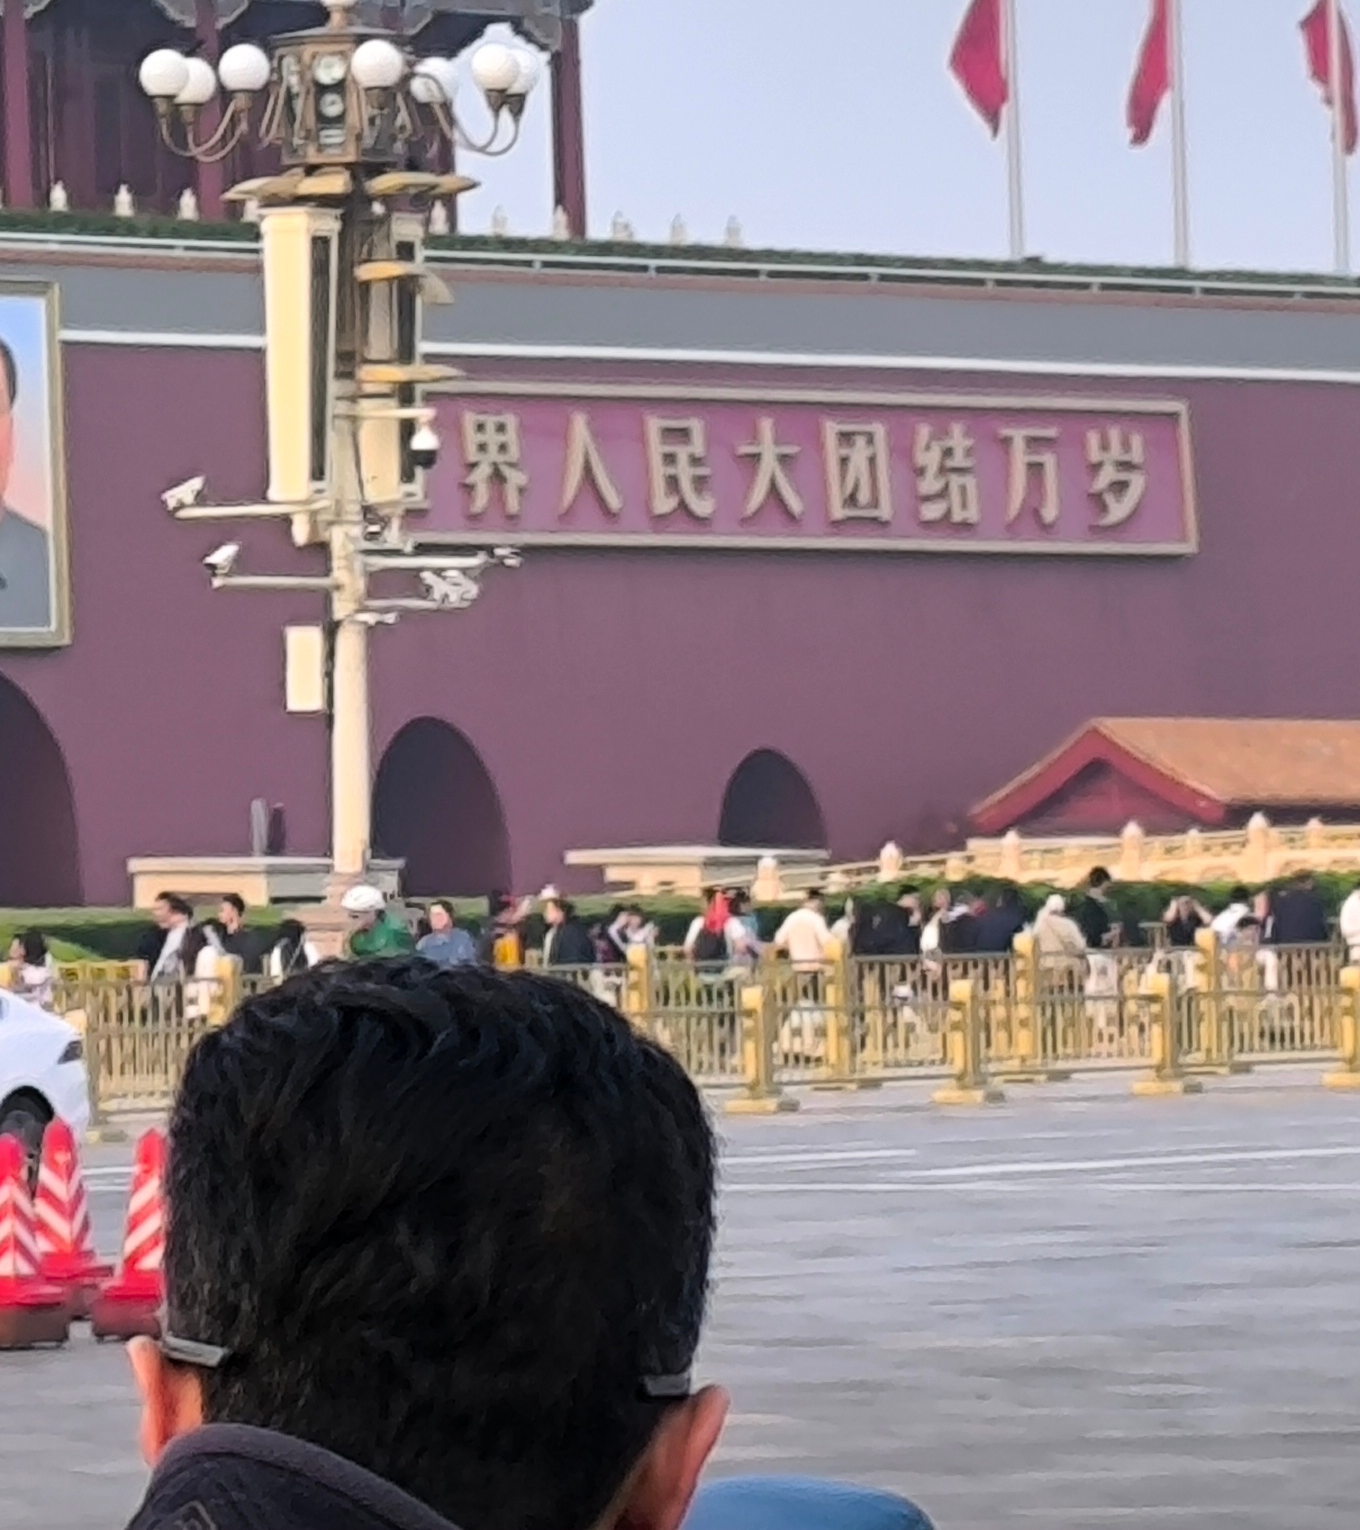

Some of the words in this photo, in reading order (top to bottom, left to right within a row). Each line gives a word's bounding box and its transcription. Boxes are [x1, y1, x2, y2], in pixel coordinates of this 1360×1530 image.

[461, 410, 1148, 528] 界人民大团结万岁
